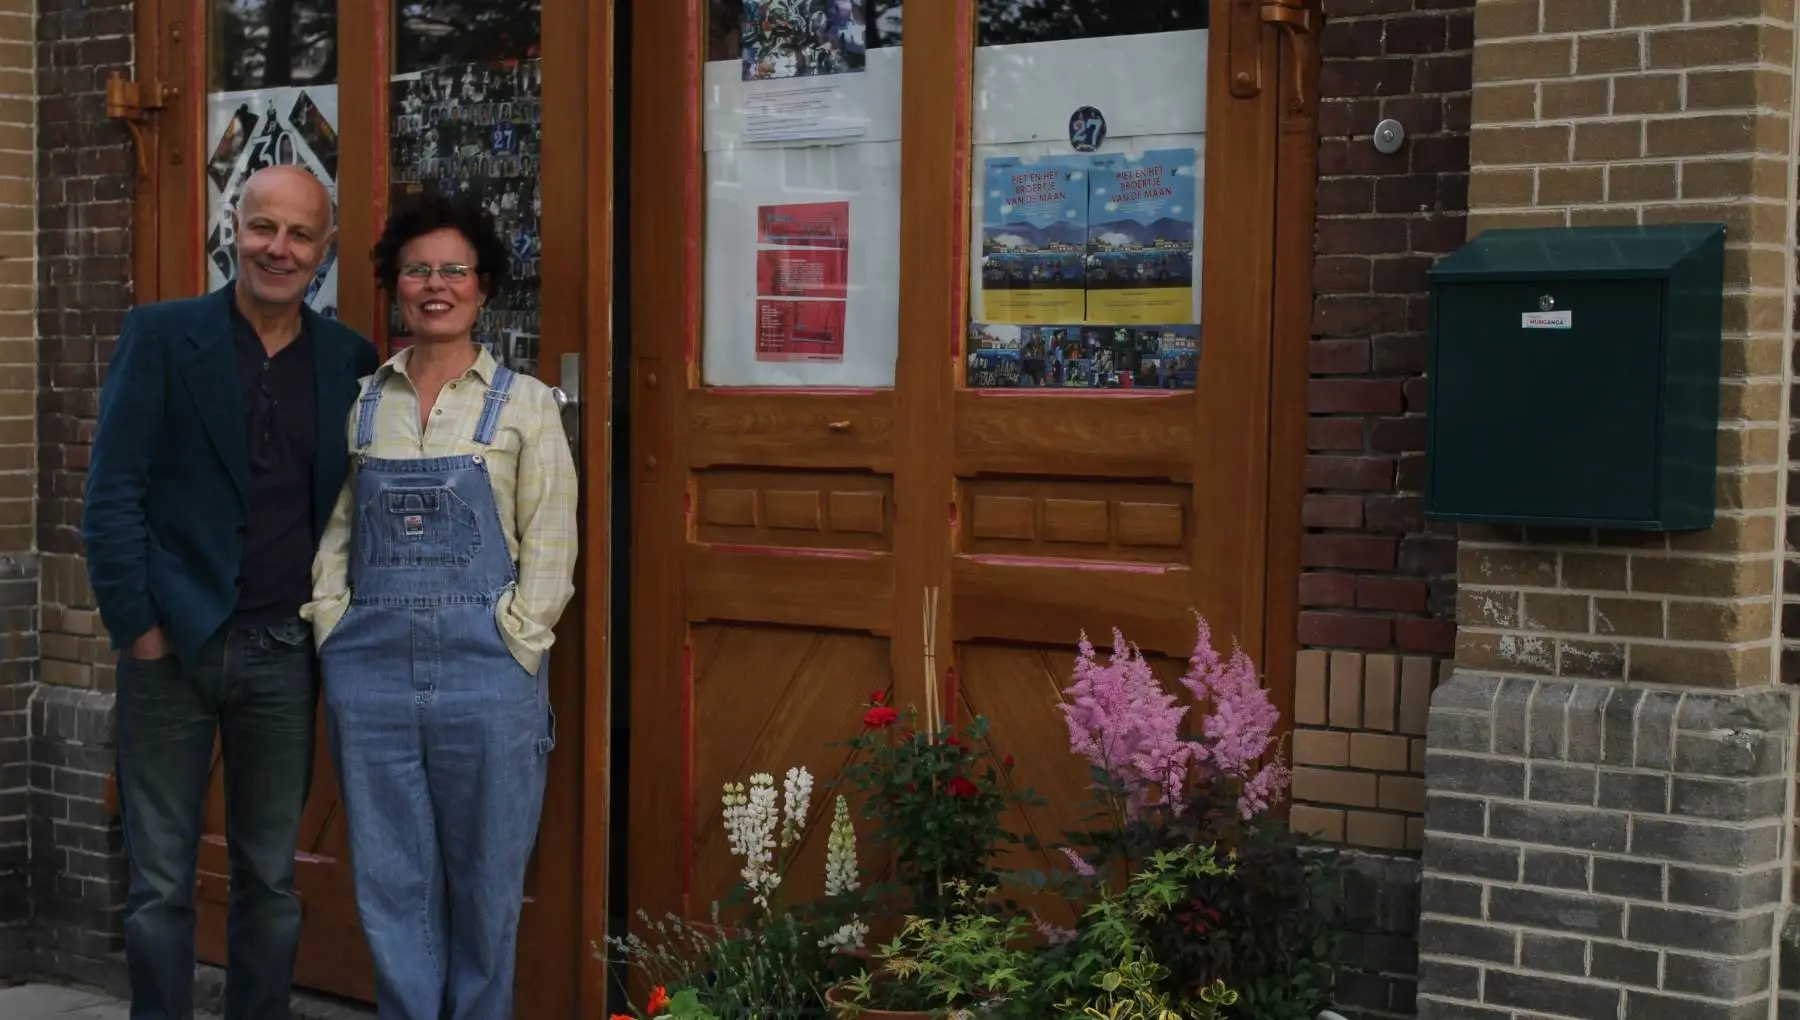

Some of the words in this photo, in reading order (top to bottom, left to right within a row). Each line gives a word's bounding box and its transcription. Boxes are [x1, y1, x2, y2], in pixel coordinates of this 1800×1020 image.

[493, 129, 514, 149] 27
[1072, 118, 1103, 146] 27
[1043, 169, 1058, 180] HET
[1148, 165, 1163, 176] HET
[1006, 196, 1024, 206] VAN
[1039, 191, 1066, 203] MAAN
[1111, 193, 1129, 203] VAN
[1144, 186, 1172, 200] MAAN
